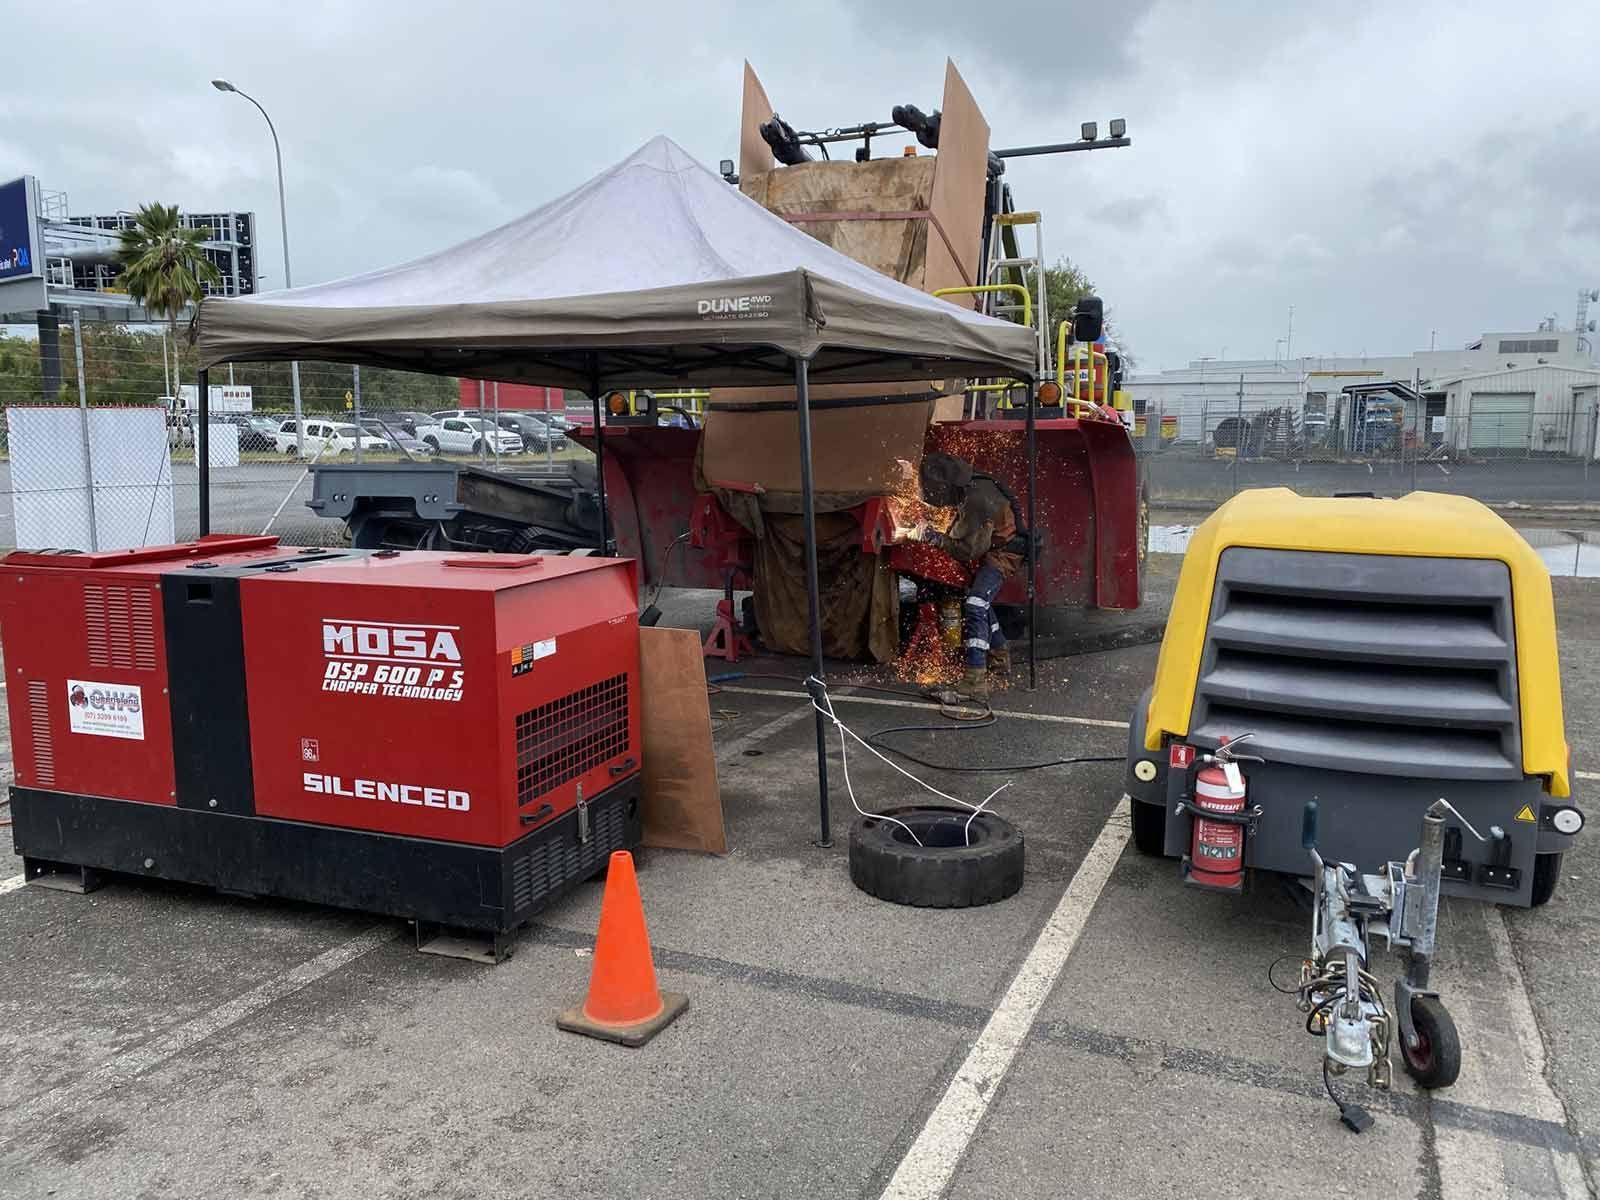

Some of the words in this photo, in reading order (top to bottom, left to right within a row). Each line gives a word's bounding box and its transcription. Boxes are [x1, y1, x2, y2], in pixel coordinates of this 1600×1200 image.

[698, 296, 750, 314] DUNE
[750, 295, 772, 303] 4WD
[322, 625, 462, 660] MOSA
[324, 661, 369, 681] DSP
[373, 665, 421, 685] 600
[426, 669, 445, 687] P
[449, 671, 465, 689] S
[322, 679, 378, 695] CHOPPER
[382, 684, 464, 702] TECHNOLOGY
[303, 773, 471, 811] SILENCED
